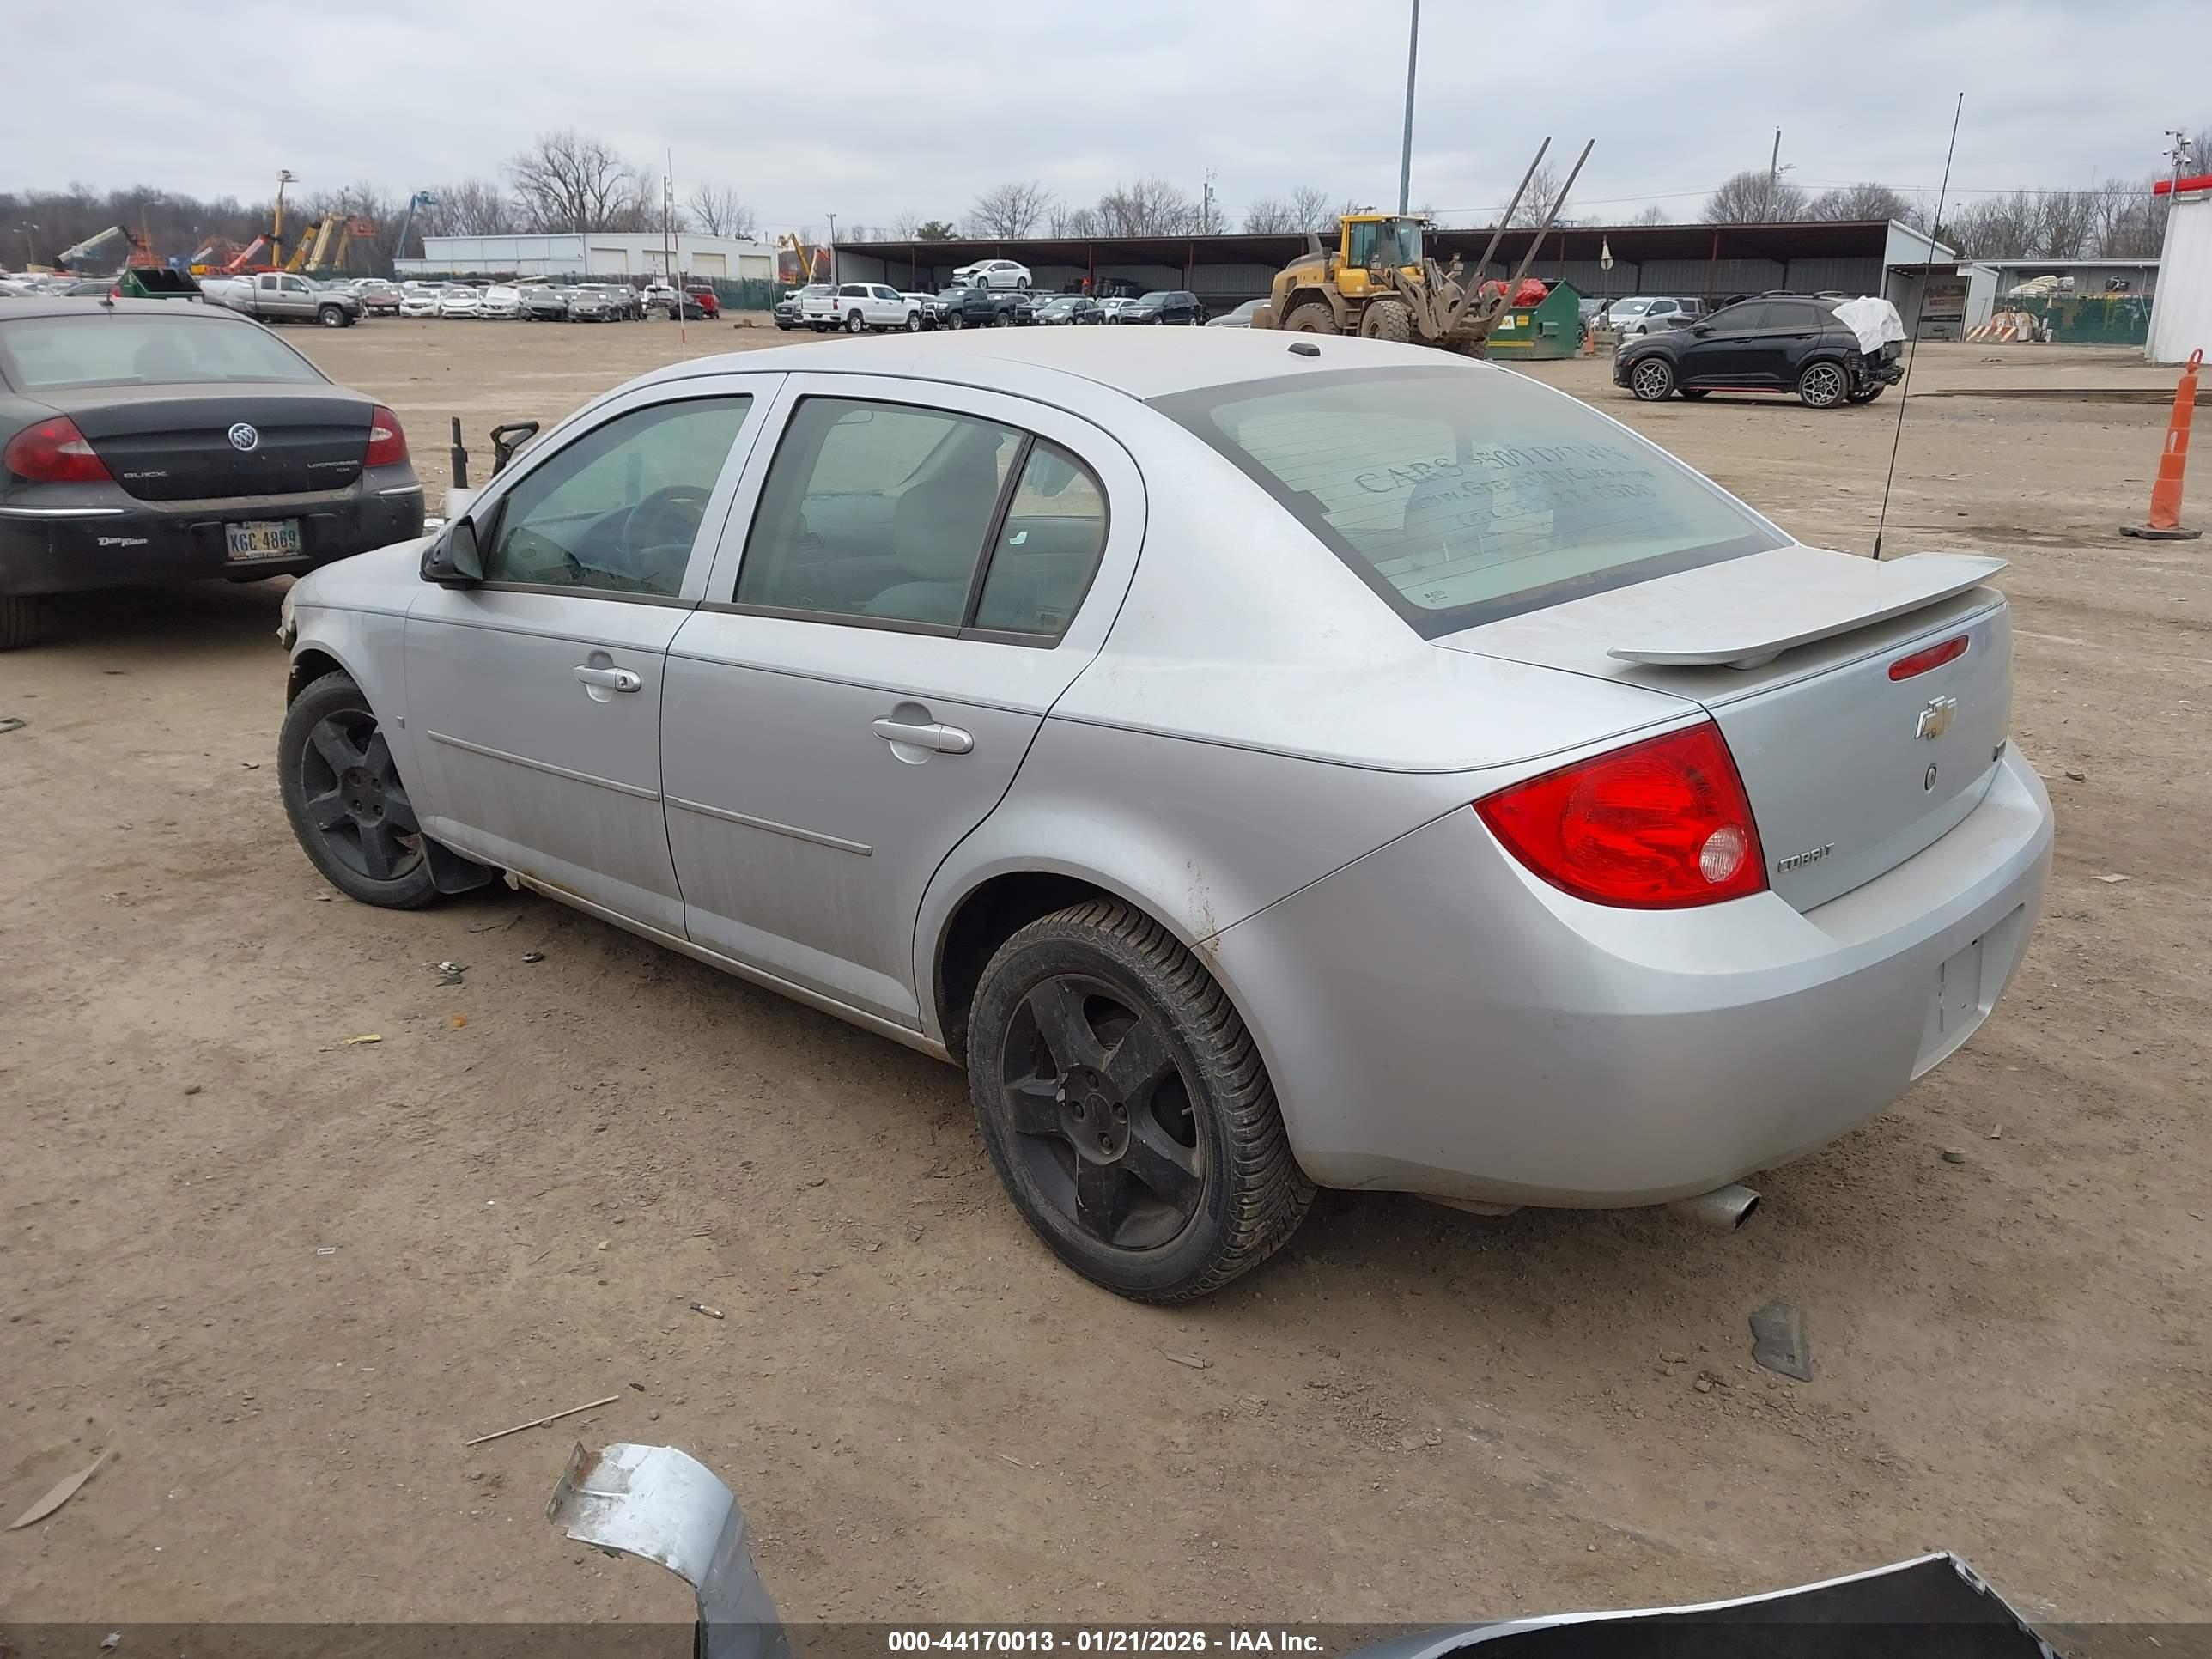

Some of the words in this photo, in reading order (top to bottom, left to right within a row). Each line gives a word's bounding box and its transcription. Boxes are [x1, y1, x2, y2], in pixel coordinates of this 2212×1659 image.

[1354, 457, 1463, 494] CARS
[230, 532, 258, 552] KGC
[263, 529, 296, 550] 4869
[1778, 842, 1835, 873] COBALT
